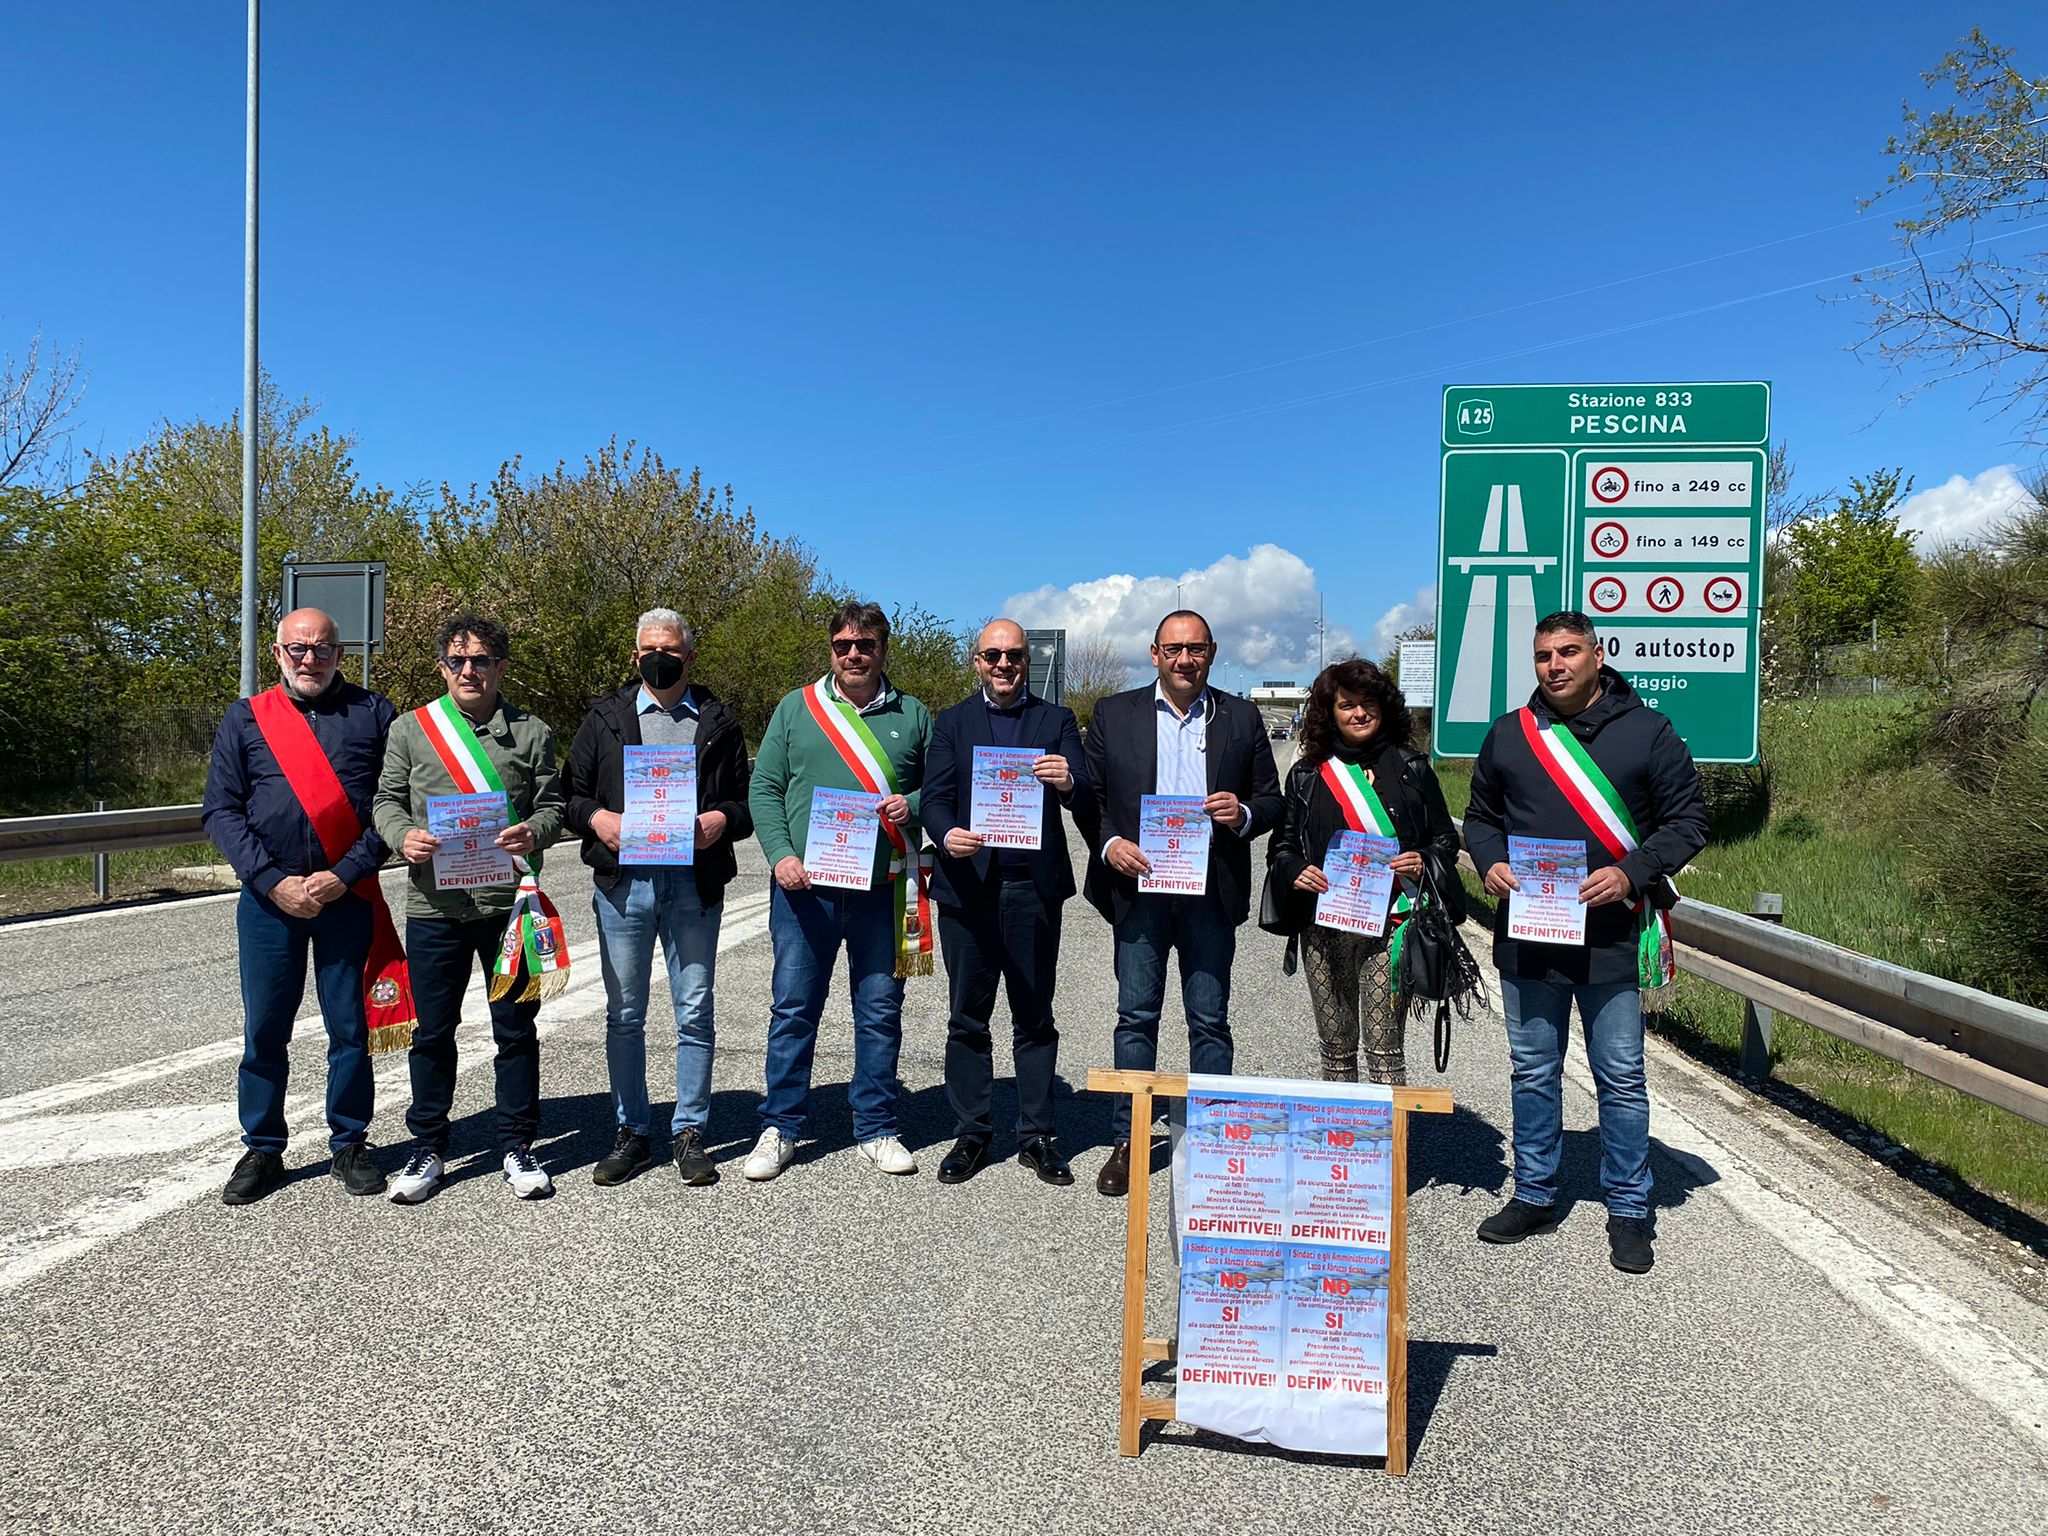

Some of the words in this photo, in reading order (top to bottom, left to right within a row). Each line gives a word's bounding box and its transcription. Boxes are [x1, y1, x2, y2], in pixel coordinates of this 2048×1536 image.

[1567, 392, 1646, 408] Stazione
[1655, 391, 1693, 407] 833
[1460, 408, 1470, 425] A
[1473, 408, 1491, 425] 25
[1570, 414, 1687, 434] PESCINA
[1634, 480, 1664, 492] fino
[1671, 483, 1681, 492] a
[1688, 480, 1720, 492] 249
[1728, 483, 1746, 492] cc
[1636, 535, 1667, 548] fino
[1674, 538, 1683, 548] a
[1691, 535, 1719, 548] 149
[1727, 538, 1745, 548] cc
[1635, 637, 1735, 663] autostop
[1627, 674, 1688, 691] daggio
[652, 767, 670, 777] NO
[1000, 770, 1018, 780] NO
[654, 789, 666, 799] SI
[1001, 792, 1012, 802] SI
[459, 816, 480, 828] NO
[836, 811, 856, 822] NO
[1166, 817, 1185, 827] NO
[464, 839, 477, 849] SI
[836, 833, 847, 844] SI
[981, 834, 1038, 845] EFINITIVE!!
[1168, 839, 1179, 849] SI
[1352, 854, 1371, 866] NO
[1537, 861, 1558, 872] NO
[440, 872, 510, 886] DEFINITIVE!!
[1142, 880, 1203, 890] DEFINITIVE!!
[1350, 876, 1362, 887] SI
[1542, 883, 1555, 894] SI
[1318, 912, 1380, 932] DEFINITIVE!!
[1512, 924, 1581, 940] DEFINITIVE!!
[1224, 1123, 1252, 1141] NO
[1327, 1130, 1355, 1148] NO
[1227, 1157, 1244, 1174] SI
[1330, 1163, 1347, 1180] SI
[1189, 1218, 1282, 1235] DEFINITIVE!!
[1291, 1224, 1386, 1242] DEFINITIVE!!
[1219, 1271, 1247, 1289] NO
[1322, 1277, 1350, 1296] NO
[1221, 1305, 1239, 1322] SI
[1325, 1311, 1342, 1329] SI
[1182, 1368, 1277, 1386] DEFINITIVE!!
